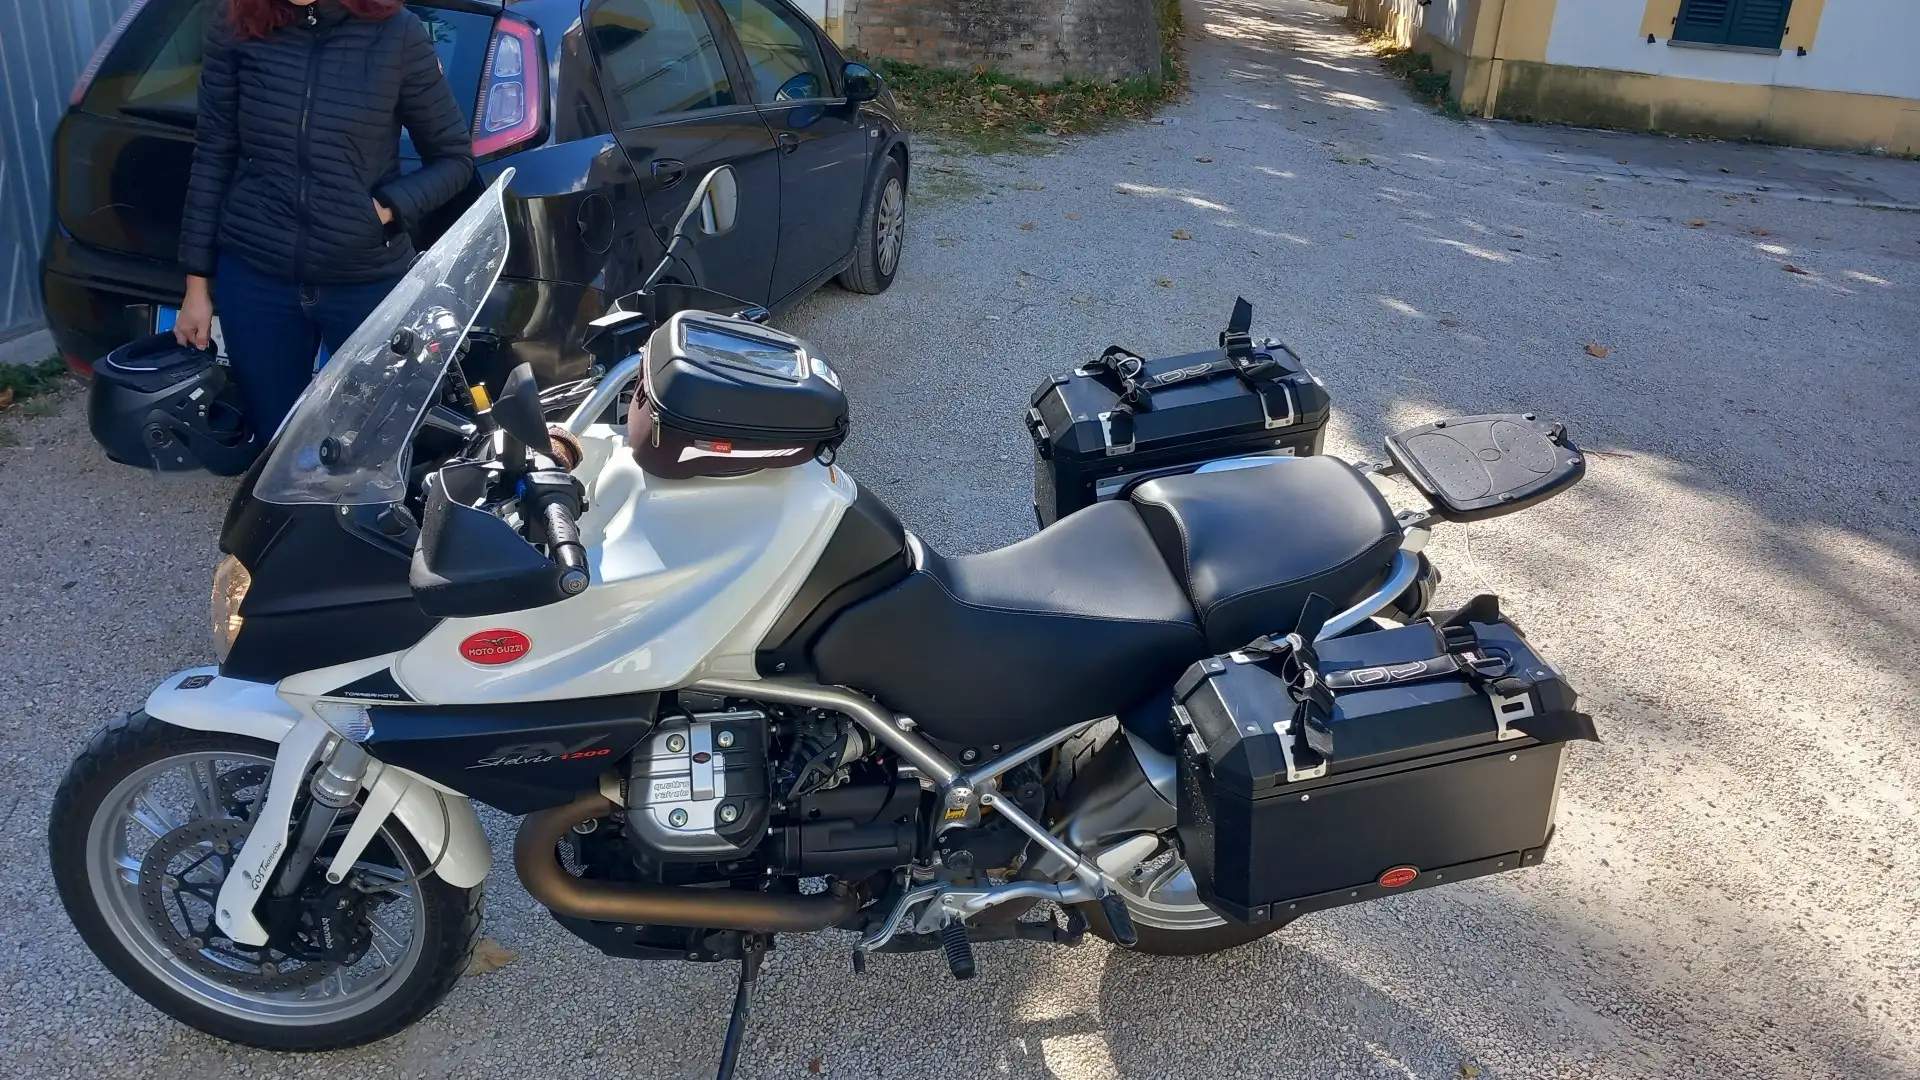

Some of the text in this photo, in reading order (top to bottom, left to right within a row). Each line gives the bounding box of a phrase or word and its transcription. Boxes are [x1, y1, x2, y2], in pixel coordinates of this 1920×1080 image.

[468, 644, 523, 656] MOTO GUZZI
[465, 749, 611, 770] Stelvio 1200
[321, 917, 334, 949] brembo
